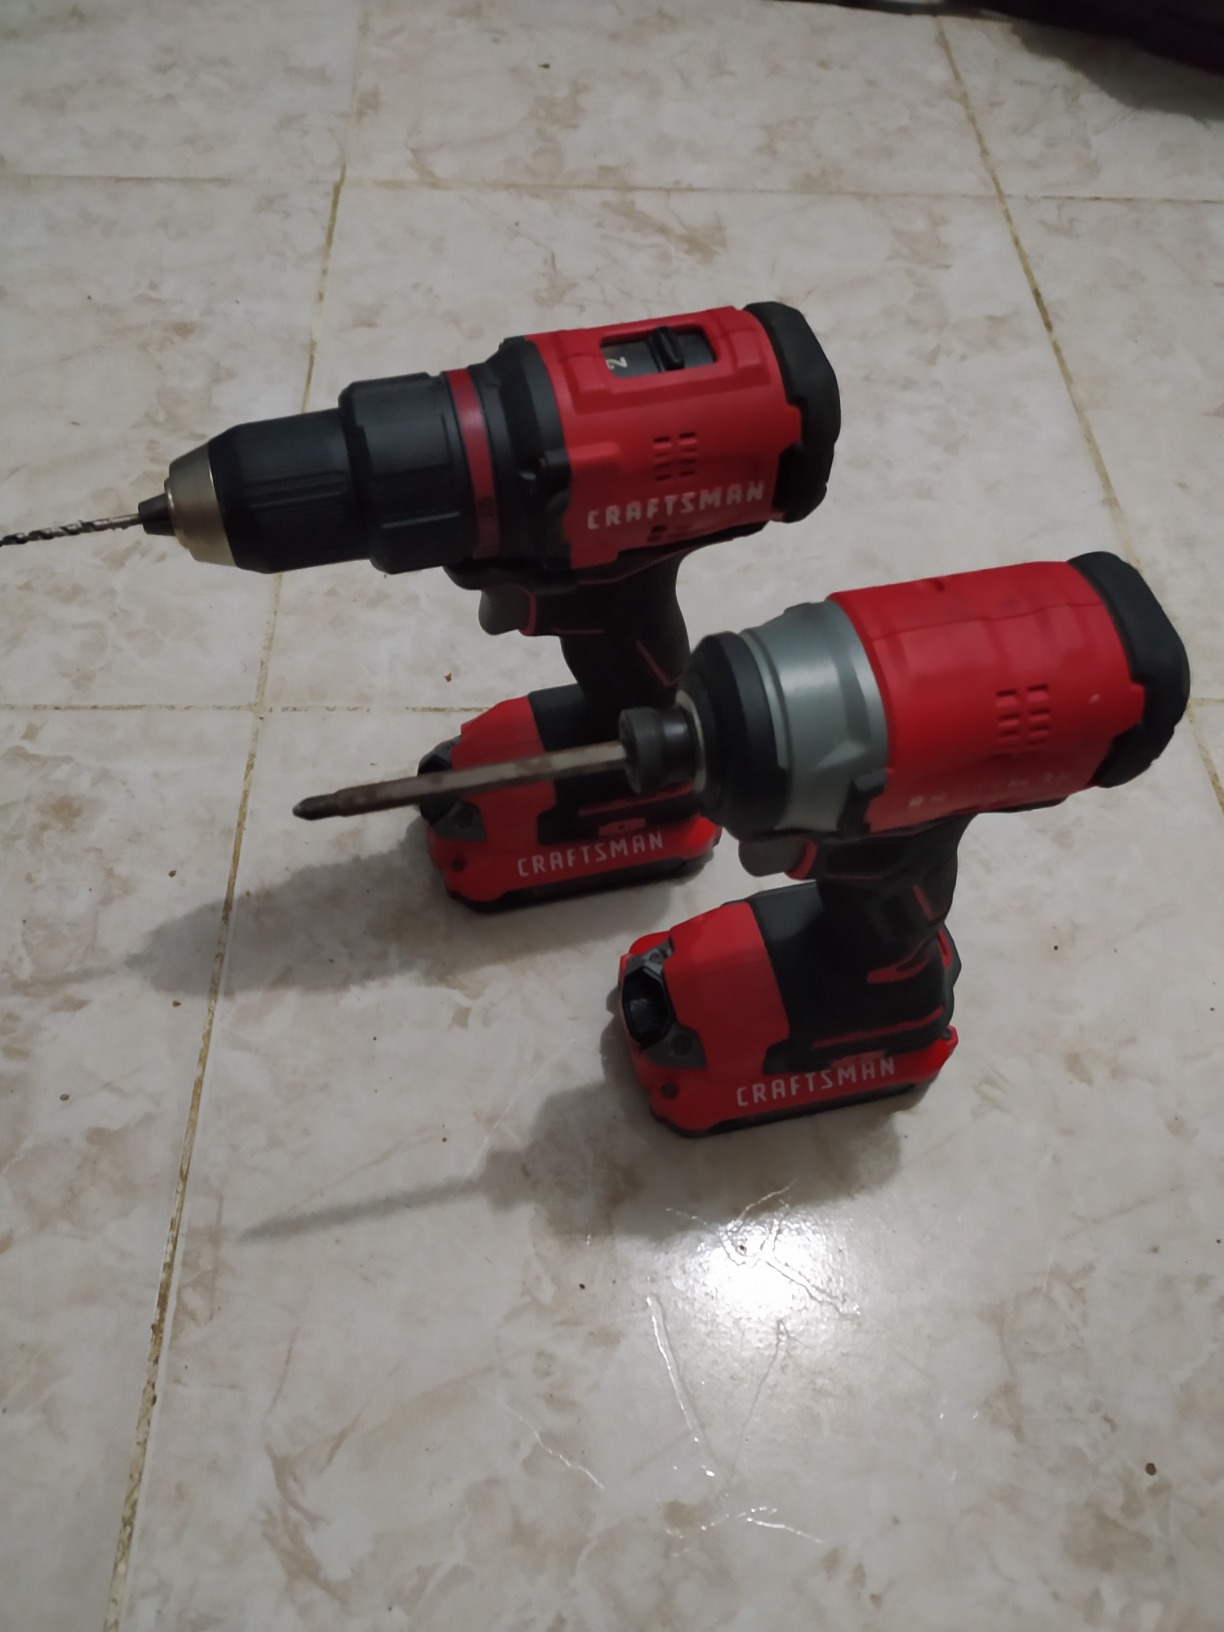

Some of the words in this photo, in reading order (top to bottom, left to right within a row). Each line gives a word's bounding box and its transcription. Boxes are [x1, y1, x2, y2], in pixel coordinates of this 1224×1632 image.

[606, 356, 628, 370] 2
[587, 480, 765, 530] CRAFTSMAN
[517, 831, 664, 877] CRAFTSMAN
[736, 1057, 896, 1107] CRAFTSMAN
